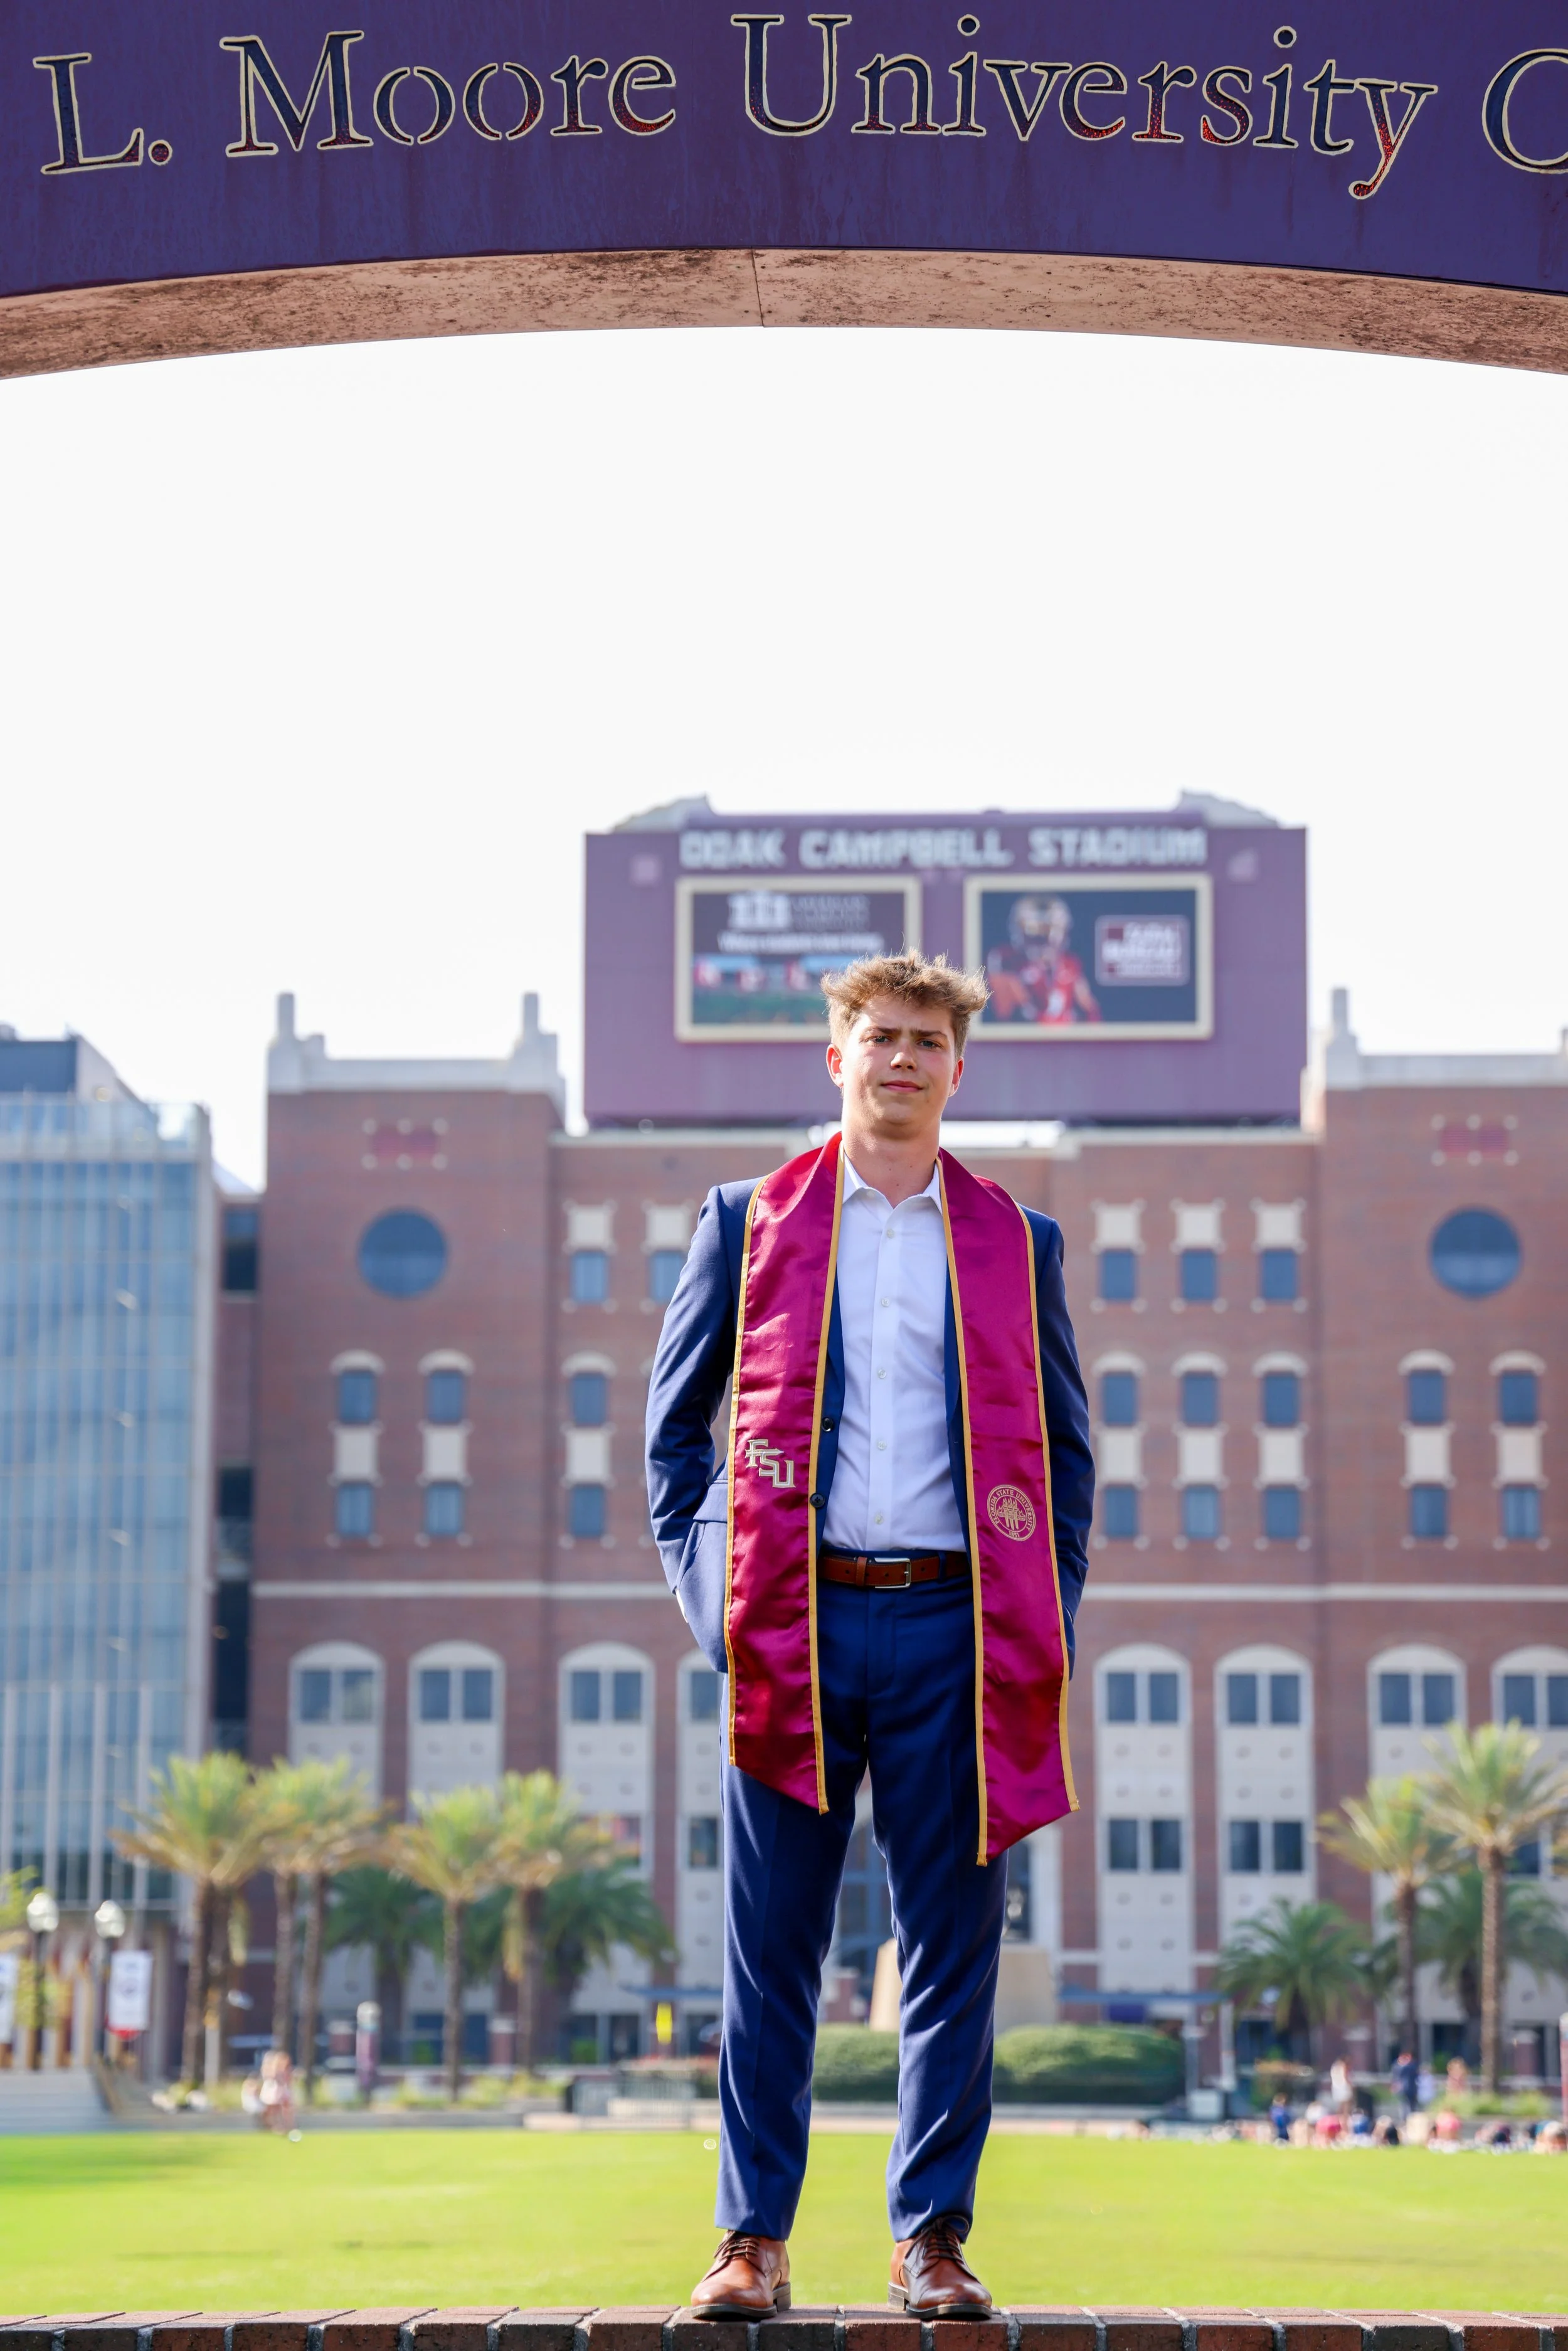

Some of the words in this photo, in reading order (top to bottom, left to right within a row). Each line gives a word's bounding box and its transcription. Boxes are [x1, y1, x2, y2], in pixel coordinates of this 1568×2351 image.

[33, 53, 173, 176] L.
[220, 29, 677, 158] Moore
[730, 13, 1439, 199] University
[681, 829, 785, 869] DOAK
[799, 827, 1015, 869] CAMPBELL
[1028, 826, 1208, 866] STADIUM
[744, 1438, 796, 1488] FSU
[990, 1496, 1000, 1525] FLORIDA
[996, 1489, 1014, 1497] STATE
[1015, 1492, 1033, 1532] UNIVERSITY
